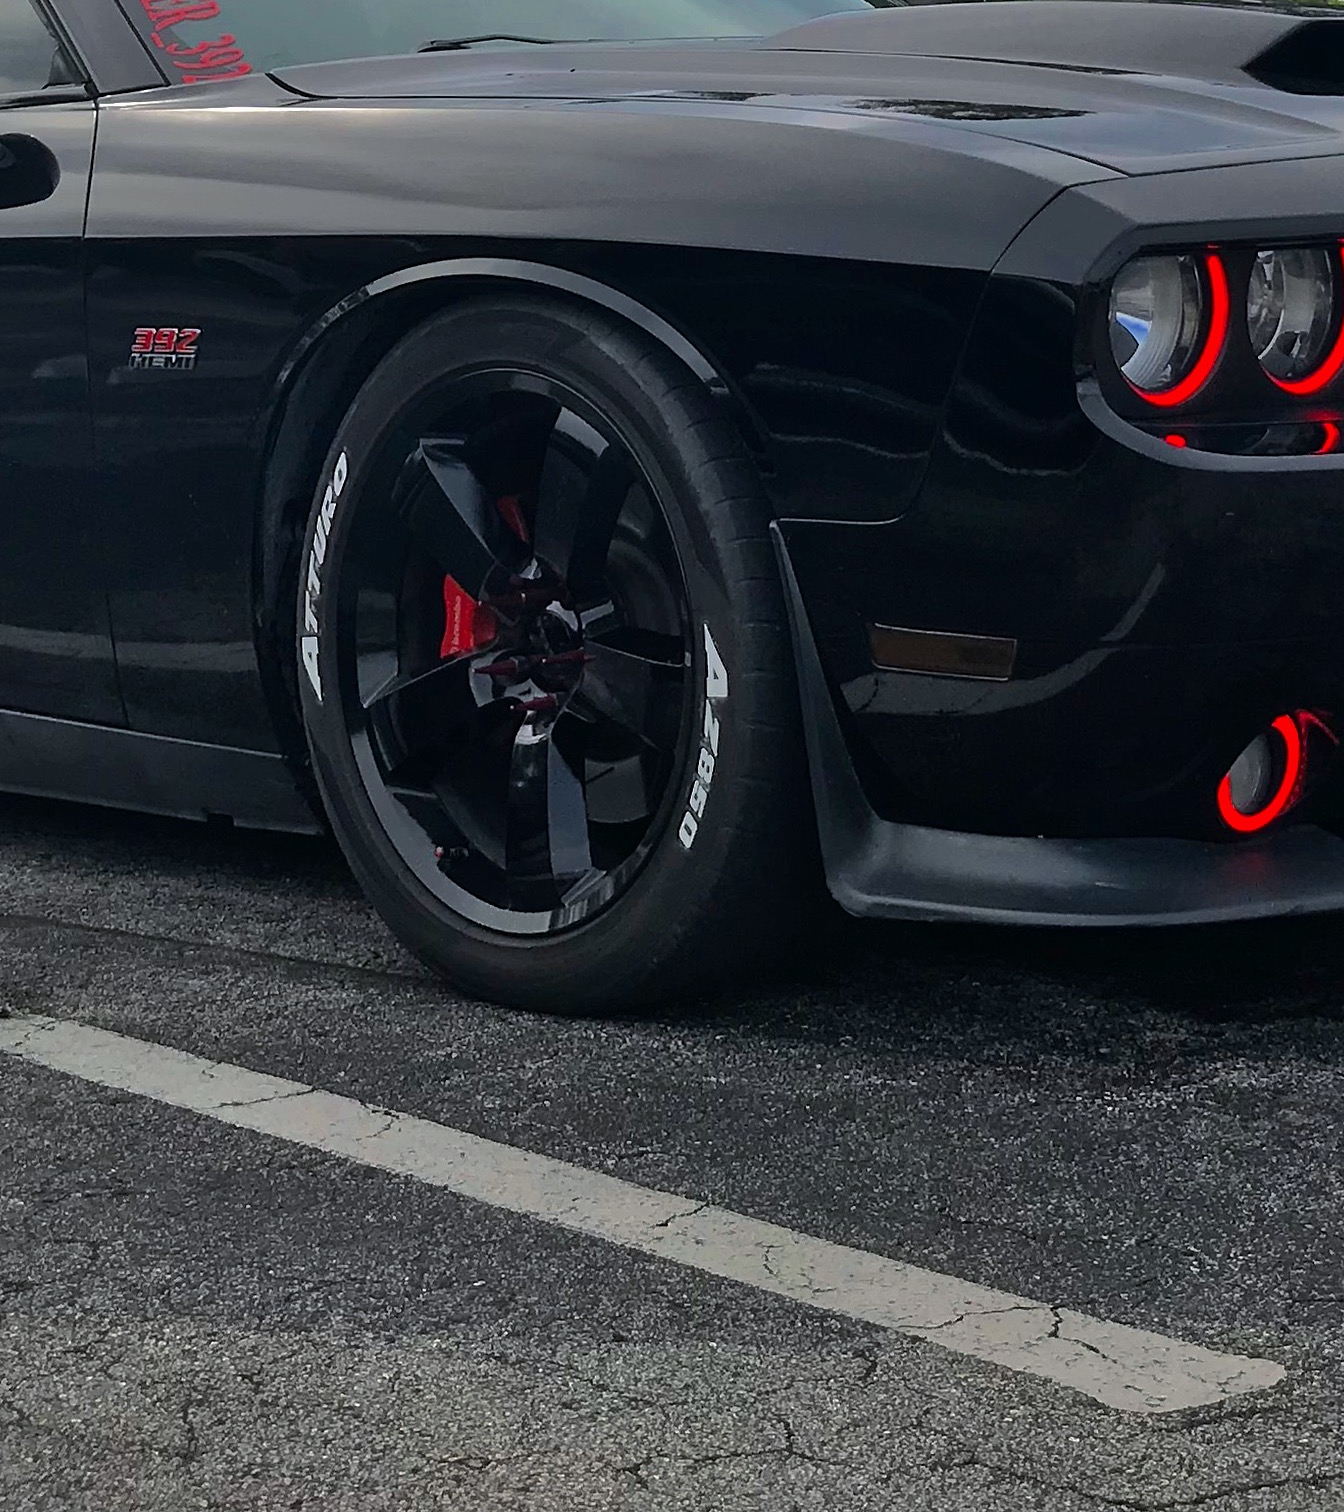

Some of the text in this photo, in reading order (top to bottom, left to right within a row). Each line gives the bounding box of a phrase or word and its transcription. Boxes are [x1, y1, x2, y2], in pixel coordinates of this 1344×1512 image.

[128, 352, 197, 370] HEMI
[131, 327, 202, 353] 392
[301, 451, 348, 702] ATTURO
[678, 622, 729, 850] AZ850
